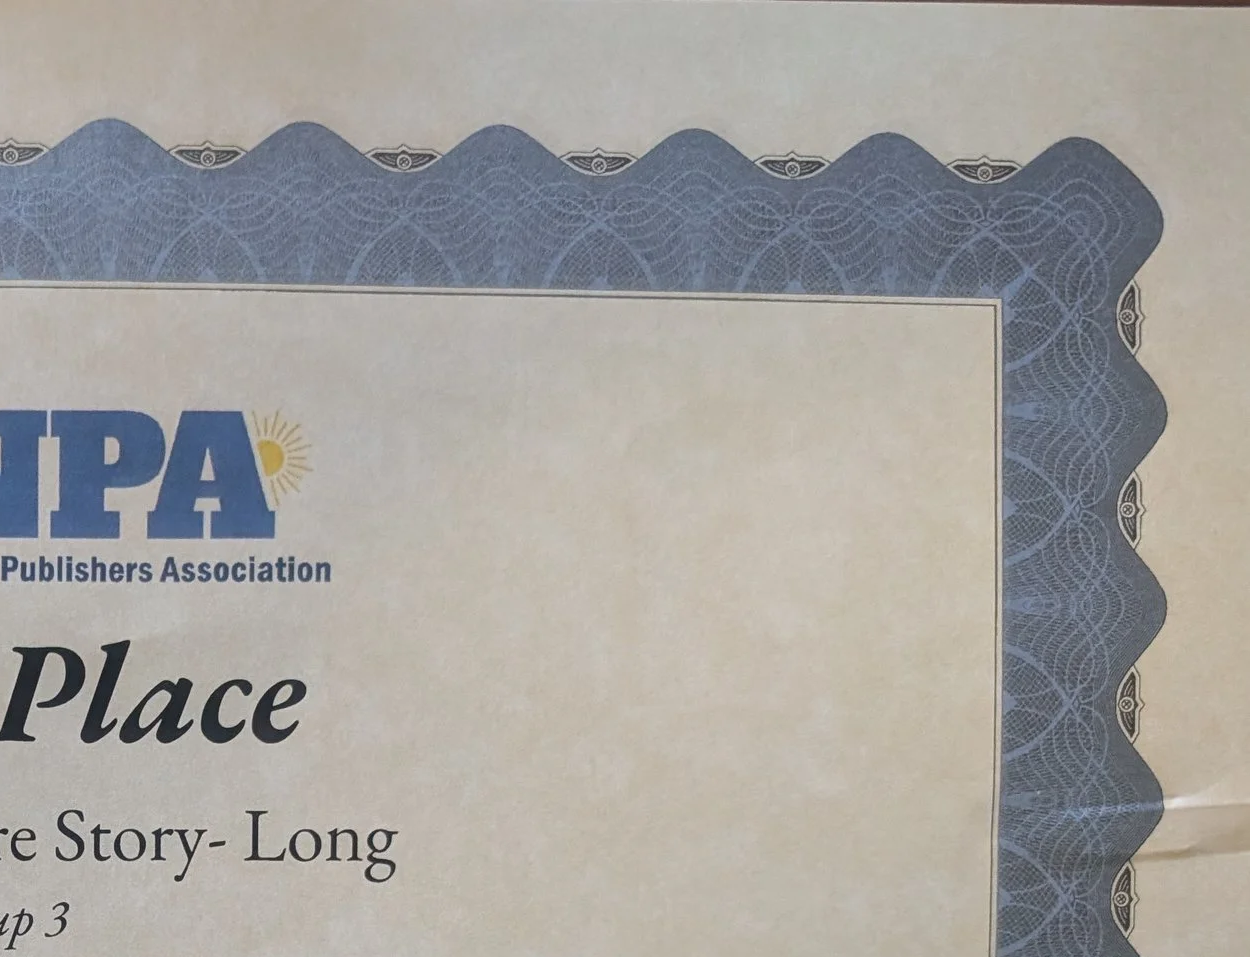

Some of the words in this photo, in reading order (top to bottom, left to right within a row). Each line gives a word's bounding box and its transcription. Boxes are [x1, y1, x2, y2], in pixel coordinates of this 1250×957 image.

[1, 555, 153, 585] Publishers
[160, 555, 332, 585] Association
[55, 810, 226, 882] Story-
[244, 810, 398, 883] Long
[45, 902, 69, 937] 3
